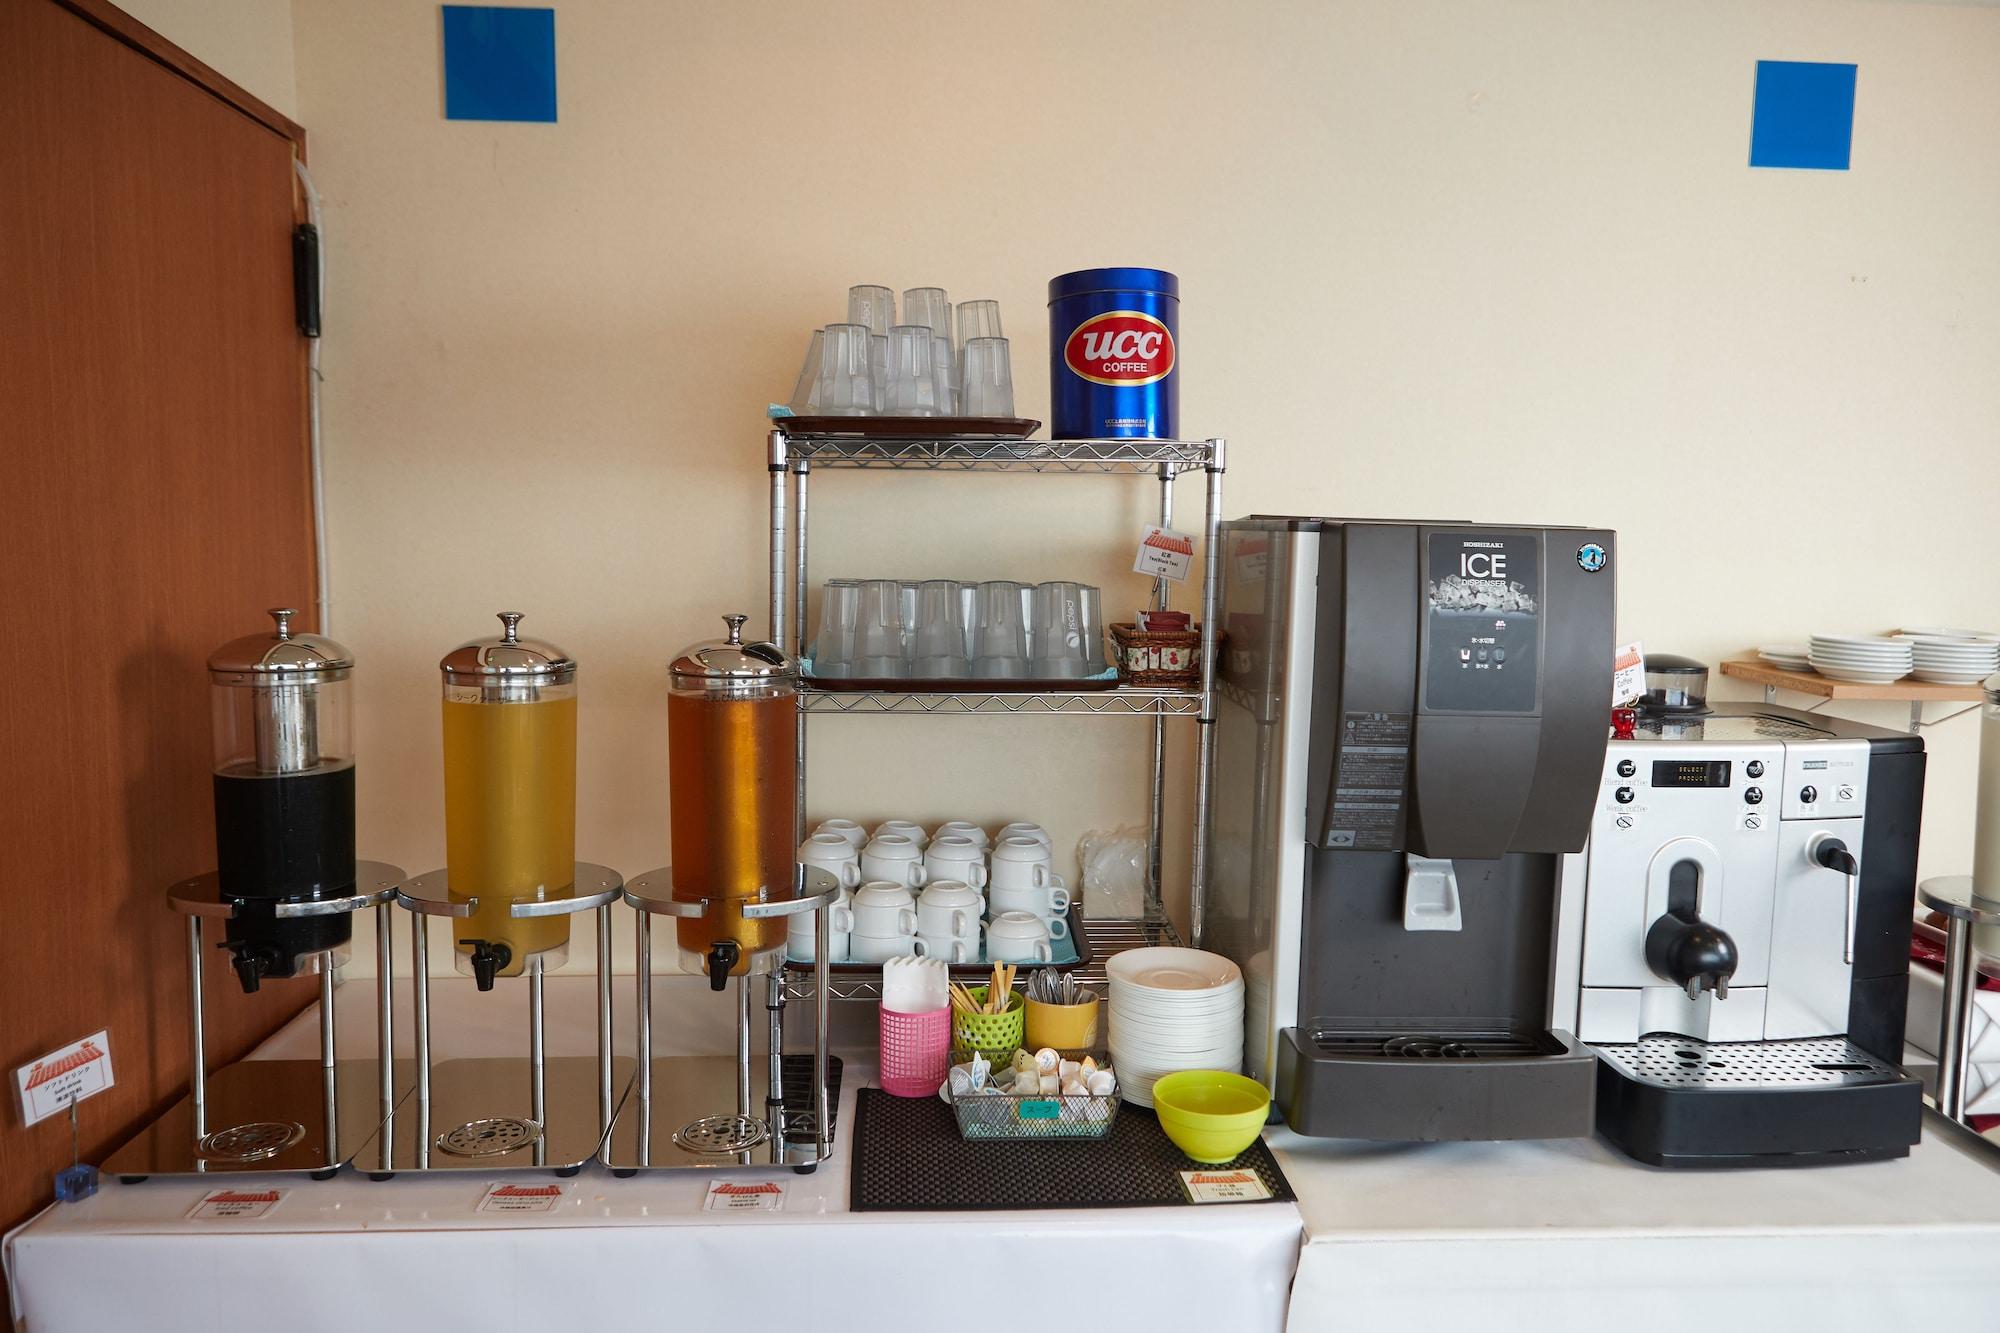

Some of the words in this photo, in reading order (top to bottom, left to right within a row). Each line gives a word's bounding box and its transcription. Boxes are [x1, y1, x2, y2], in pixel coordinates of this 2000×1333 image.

[1083, 330, 1162, 360] UCC
[1103, 363, 1148, 372] COFFEE
[1463, 541, 1504, 549] HOSHIZAKI
[1461, 553, 1506, 578] ICE
[1461, 579, 1506, 587] DISPENSER
[1066, 600, 1077, 630] pepsi
[1617, 677, 1633, 688] Coffee
[1605, 778, 1624, 786] Blend
[1627, 778, 1648, 786] coffee
[1606, 804, 1622, 812] Weak
[1626, 804, 1648, 812] coffee
[44, 1066, 90, 1093] ソフトドリンク
[1027, 1105, 1052, 1113] スープ
